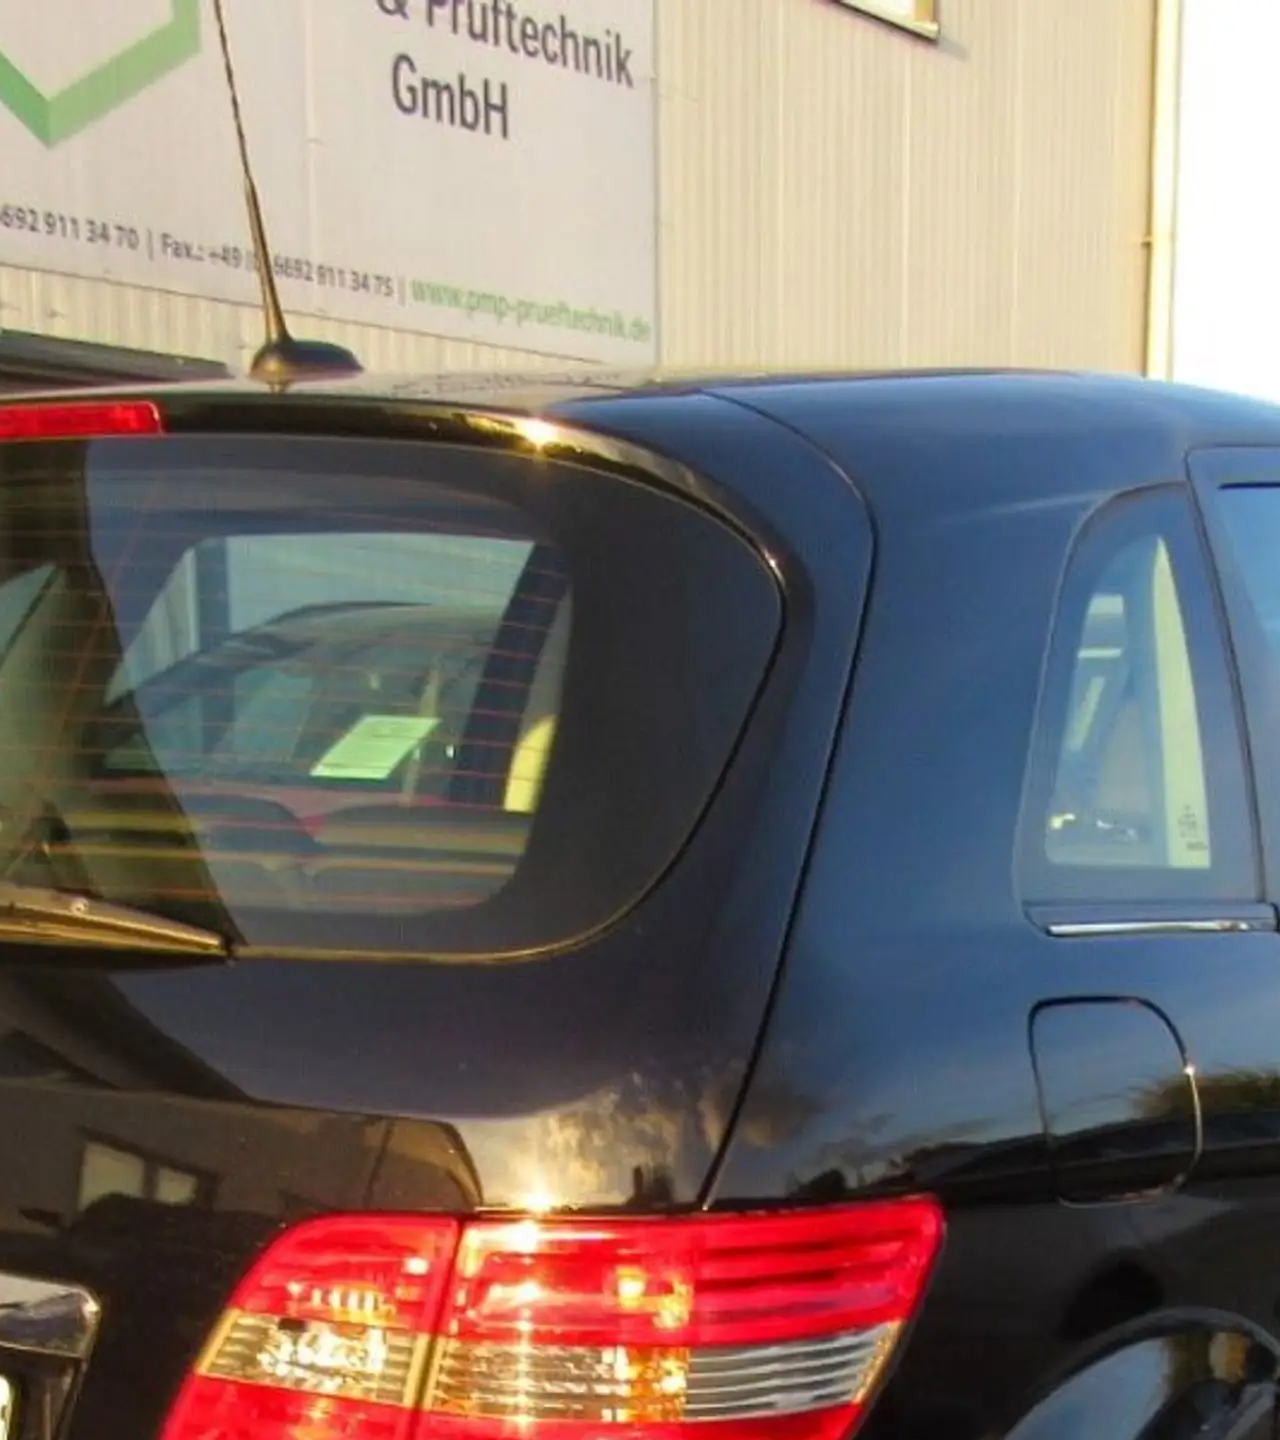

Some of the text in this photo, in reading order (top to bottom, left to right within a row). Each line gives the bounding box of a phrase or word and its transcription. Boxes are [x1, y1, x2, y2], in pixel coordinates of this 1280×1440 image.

[392, 52, 509, 140] GmbH
[44, 213, 80, 239] 911
[85, 220, 112, 244] 34
[114, 224, 140, 250] 70
[160, 231, 205, 262] Fax.:
[351, 267, 370, 292] 34
[374, 274, 394, 297] 75
